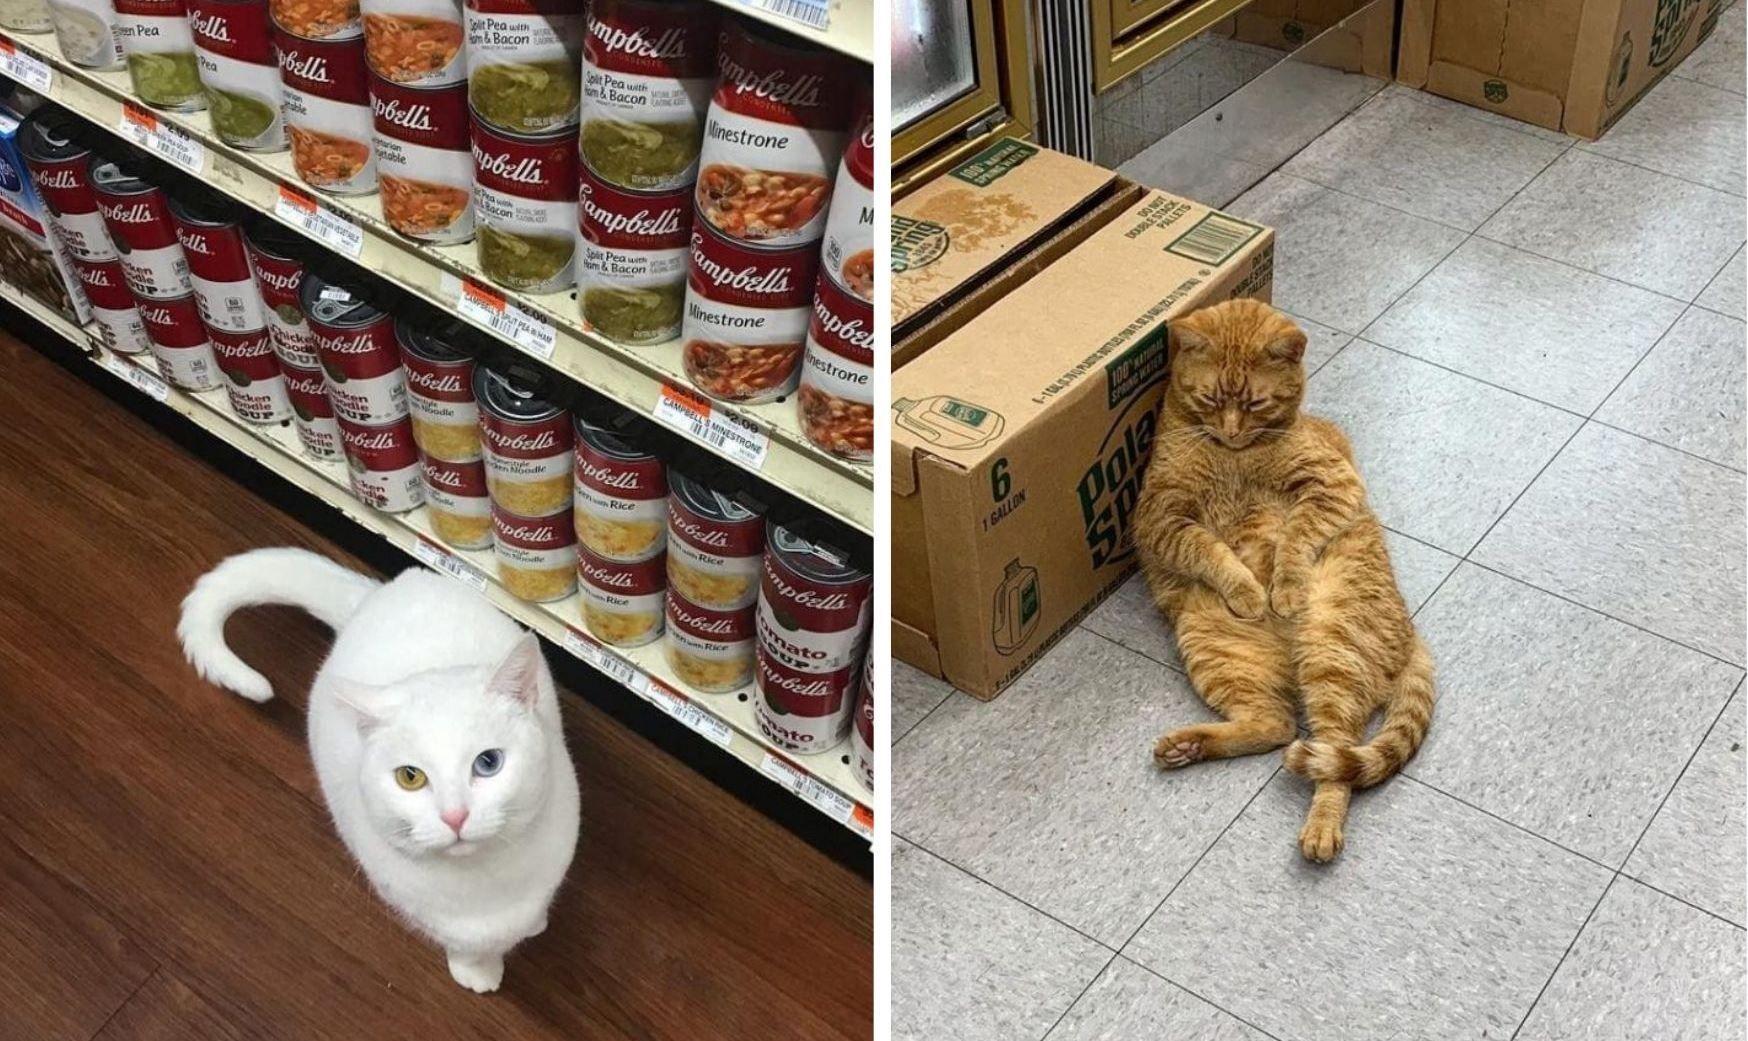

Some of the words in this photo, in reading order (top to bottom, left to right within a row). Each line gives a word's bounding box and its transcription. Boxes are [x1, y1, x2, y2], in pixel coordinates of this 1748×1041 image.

[137, 24, 160, 37] Pea
[487, 18, 507, 30] Pea
[509, 23, 530, 31] with
[484, 32, 491, 44] &
[493, 32, 530, 45] Bacon
[715, 31, 822, 107] Campbell's
[604, 74, 625, 89] Pea
[627, 83, 648, 92] with
[599, 86, 607, 99] &
[609, 89, 647, 105] Bacon
[708, 119, 790, 149] Minestrone
[580, 183, 682, 236] Campbell's
[1124, 216, 1156, 240] DOUBLE
[1154, 200, 1181, 222] STACK
[1136, 205, 1151, 219] DO
[1156, 204, 1192, 230] PALLETS
[601, 261, 608, 272] &
[610, 263, 646, 274] Bacon
[605, 251, 626, 263] Pea
[628, 256, 648, 264] with
[690, 231, 793, 293] Campbell's
[688, 302, 766, 328] Minestrone
[663, 397, 703, 425] CAMPBELL
[711, 421, 762, 455] MINESTRONE
[991, 457, 1011, 503] 6
[1076, 409, 1156, 534] Pola
[610, 500, 636, 511] Rice
[982, 518, 988, 532] 1
[990, 488, 1026, 527] GALLON
[1086, 462, 1144, 571] Sp
[698, 553, 724, 566] Rice
[606, 595, 629, 606] Rice
[704, 643, 729, 652] Rice
